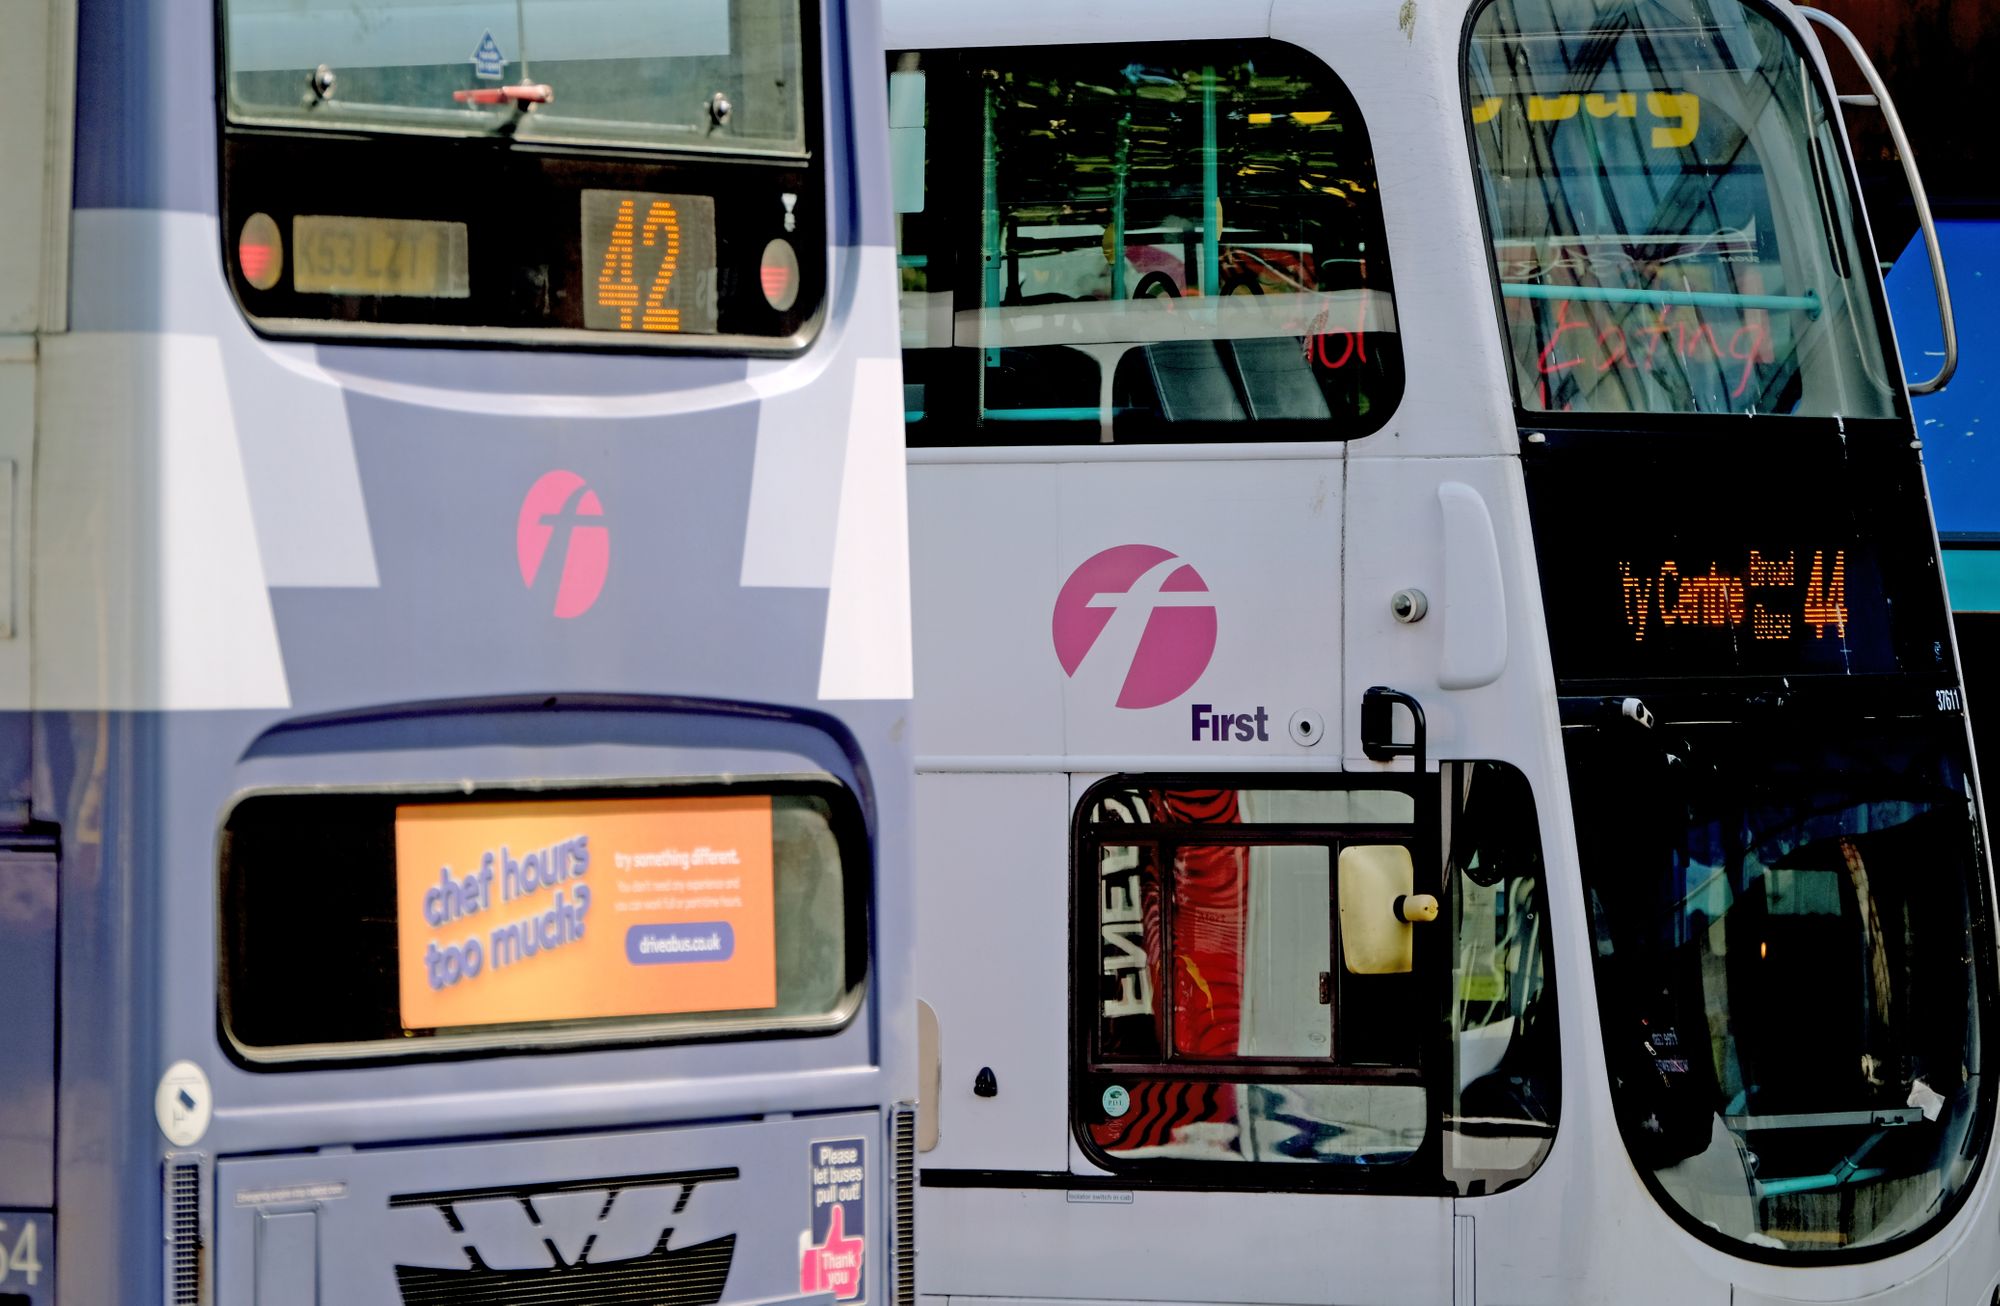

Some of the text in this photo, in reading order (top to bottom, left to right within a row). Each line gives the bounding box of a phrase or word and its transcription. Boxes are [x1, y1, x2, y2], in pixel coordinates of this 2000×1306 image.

[598, 200, 679, 331] 42
[1619, 561, 1652, 641] ty
[1804, 550, 1848, 638] 44
[1936, 689, 1960, 711] 37611
[1191, 704, 1269, 741] First
[424, 834, 590, 927] chef hours
[425, 884, 592, 991] too much?
[639, 931, 721, 954] driveabus.co.uk
[820, 1148, 858, 1165] Please
[813, 1167, 863, 1184] let buses
[816, 1186, 836, 1206] pull
[822, 1252, 856, 1270] Thank
[828, 1271, 848, 1290] you
